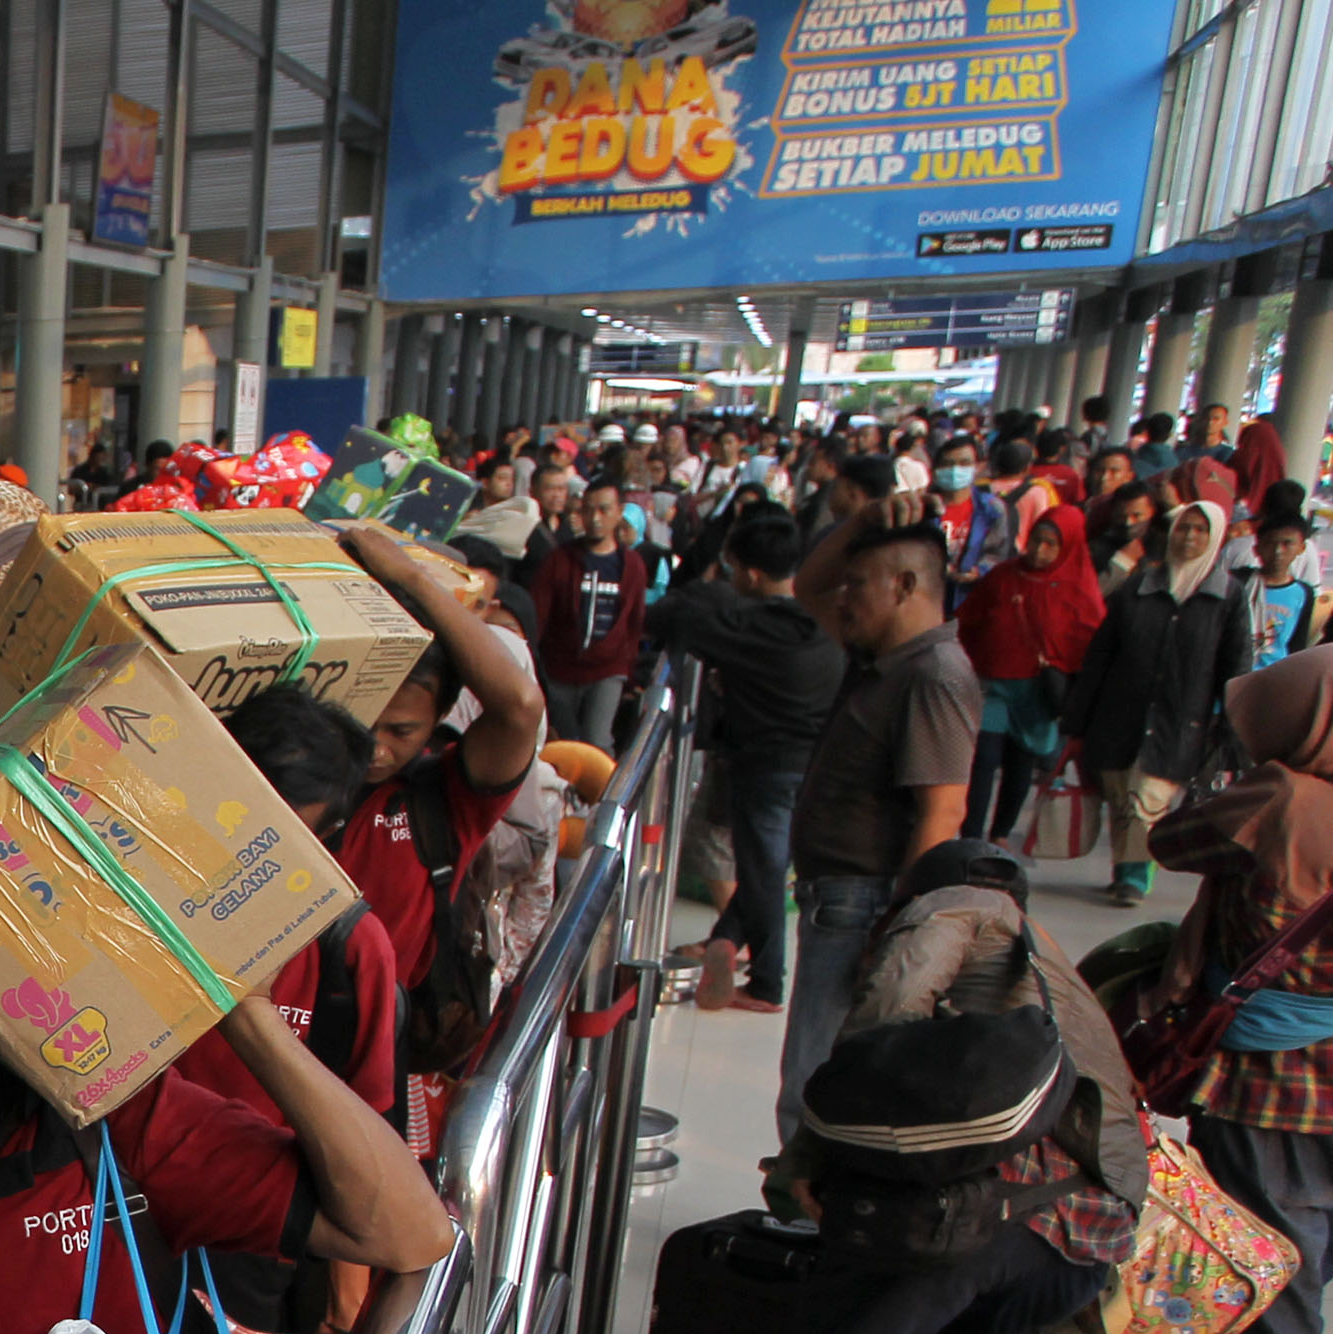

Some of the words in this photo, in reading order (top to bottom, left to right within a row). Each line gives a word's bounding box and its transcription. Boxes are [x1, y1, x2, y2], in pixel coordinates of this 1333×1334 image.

[797, 27, 867, 52] TOTAL
[871, 19, 967, 46] HADIAH
[986, 13, 1062, 34] MILIAR
[524, 56, 718, 127] DANA
[791, 68, 872, 92] KIRIM
[878, 61, 958, 87] UANG
[967, 53, 1053, 78] SETIAP
[783, 86, 897, 118] BONUS
[965, 71, 1055, 103] HARI
[498, 117, 737, 192] BEDUG
[782, 133, 896, 162] BUKBER
[901, 123, 1044, 153] MELEDUG
[772, 155, 906, 192] SETIAP
[910, 145, 1046, 182] JUMAT
[918, 205, 1022, 227] DOWNLOAD
[1025, 201, 1120, 221] SEKARANG
[1042, 237, 1069, 251] App
[1071, 234, 1105, 248] Store
[236, 826, 281, 868] BAYI
[211, 860, 282, 921] CELANA
[274, 1005, 313, 1025] RTE
[54, 1023, 101, 1062] XL
[149, 1028, 173, 1050] Extra
[24, 1203, 97, 1238] PORT
